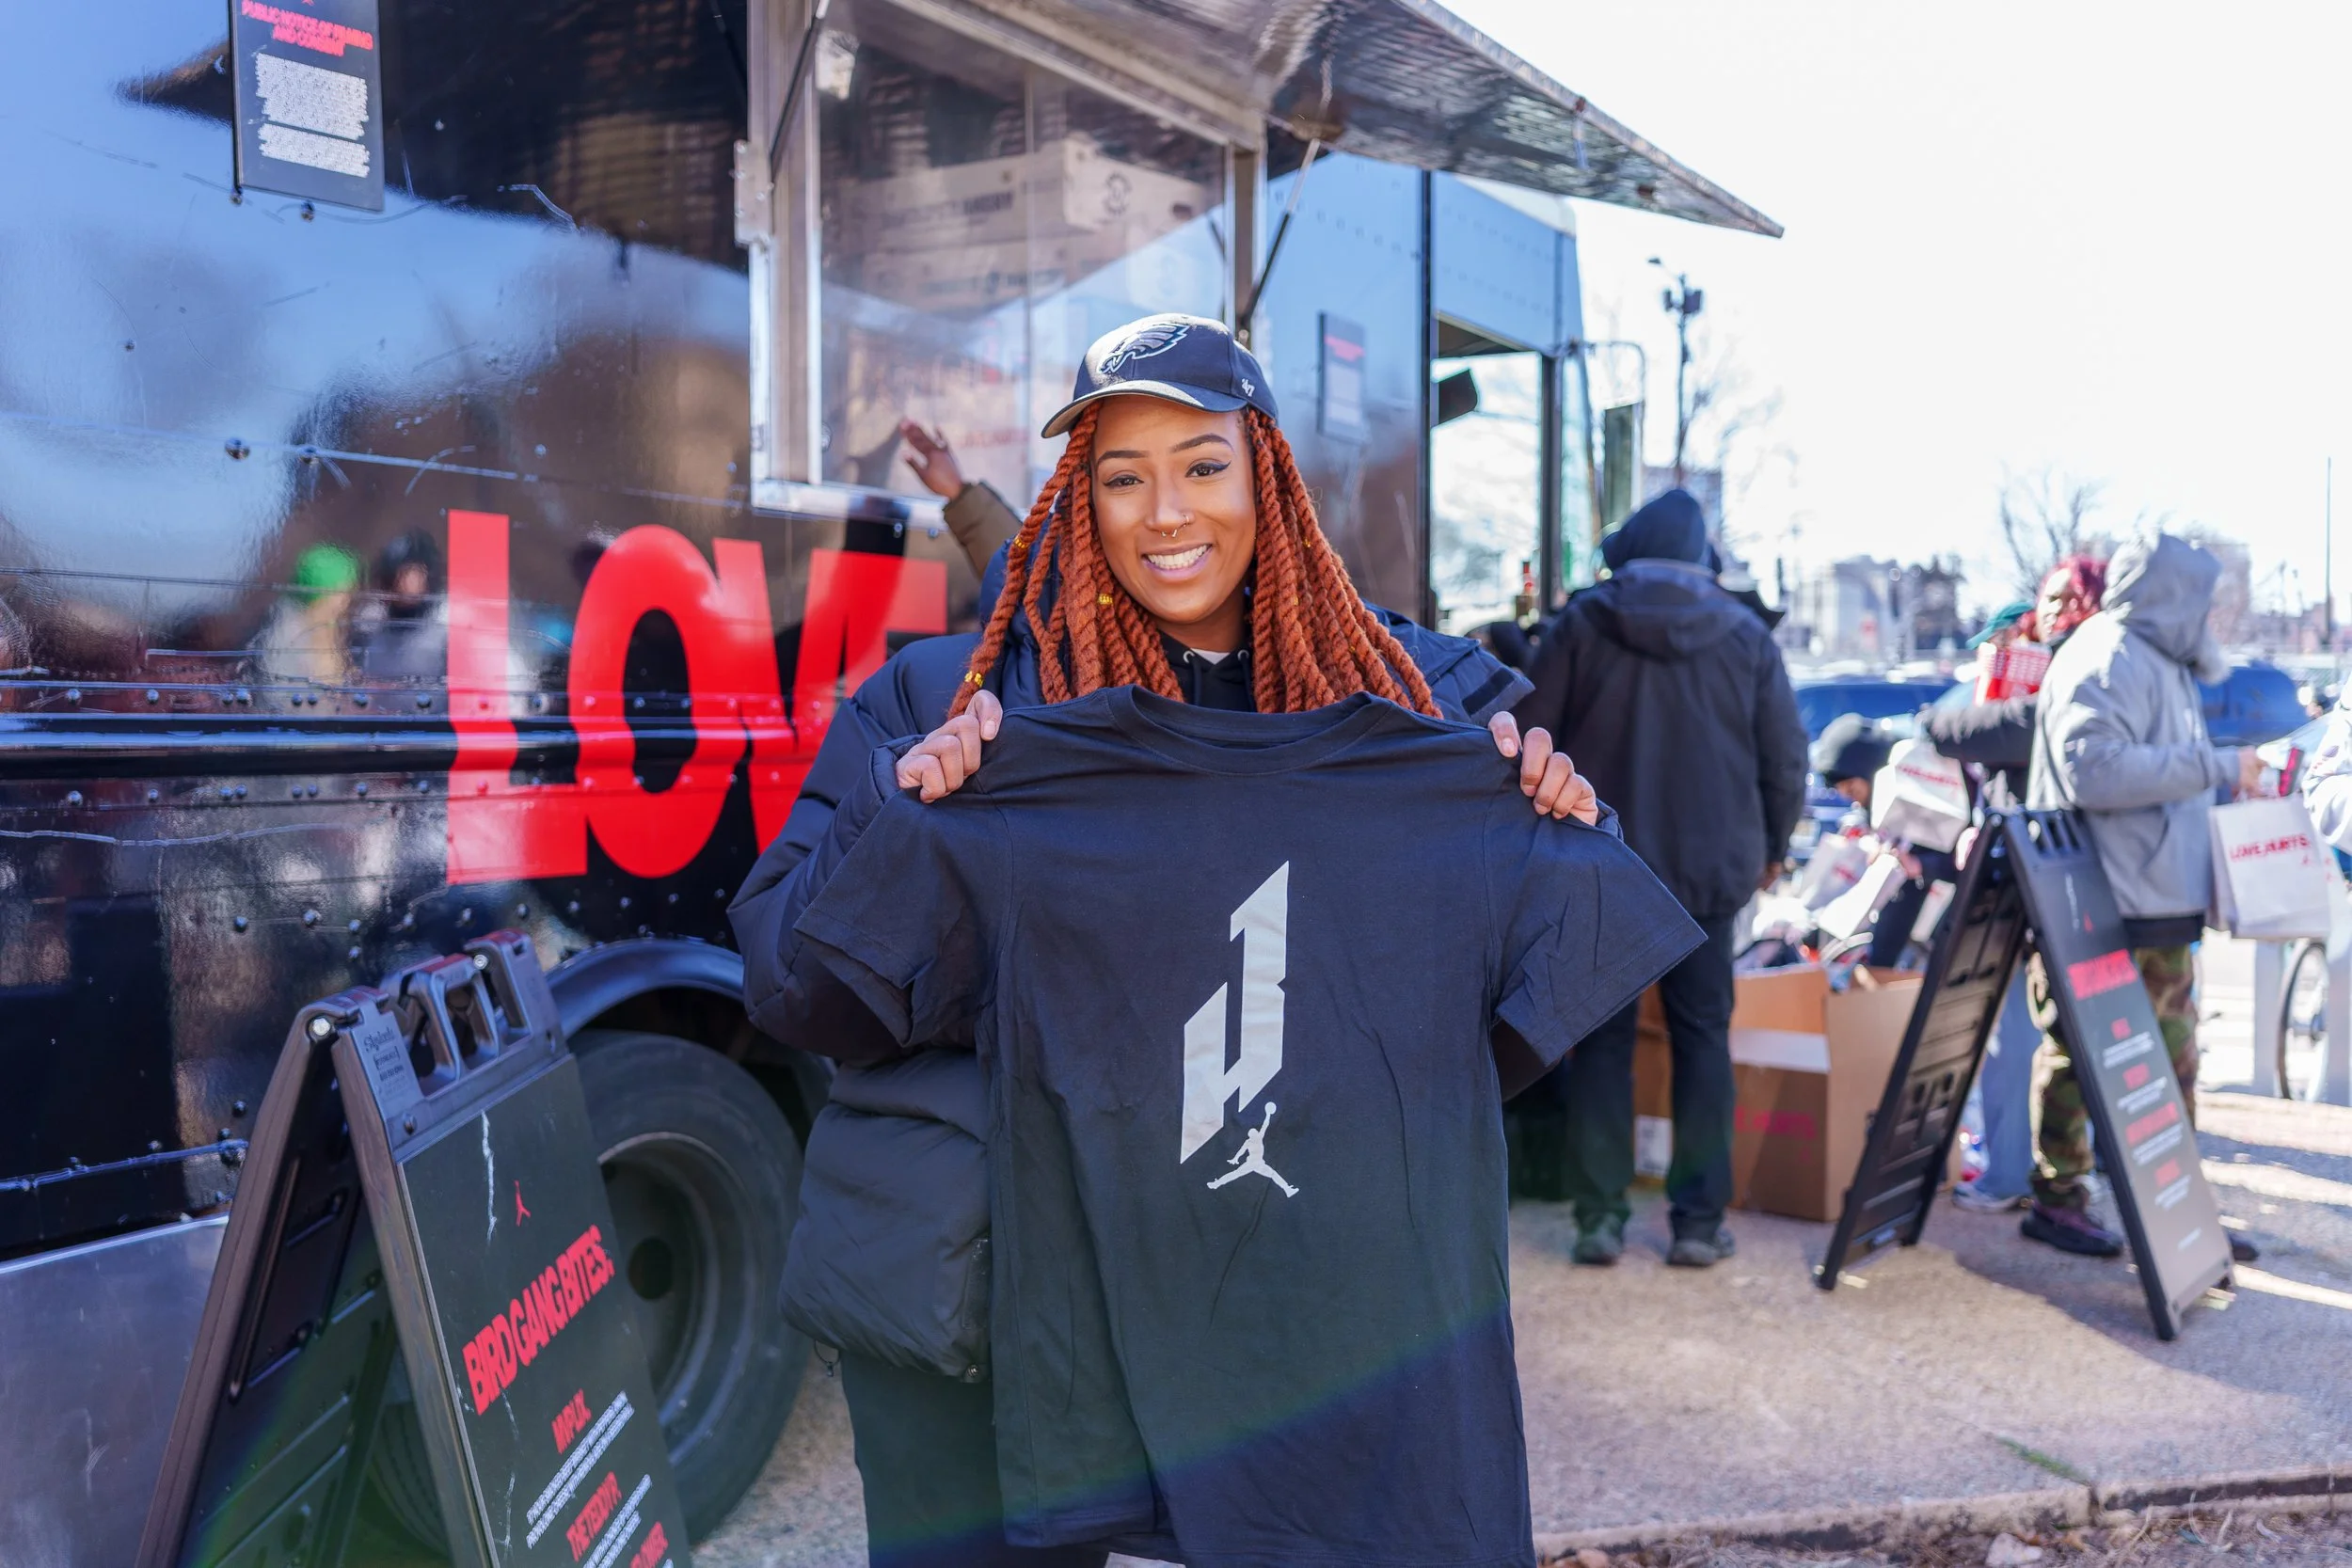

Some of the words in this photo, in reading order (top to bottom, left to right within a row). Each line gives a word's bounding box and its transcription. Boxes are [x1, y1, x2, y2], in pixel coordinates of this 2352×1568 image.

[462, 1313, 518, 1416] BIRD
[509, 1265, 569, 1367] GANG
[556, 1224, 615, 1321] BITES.
